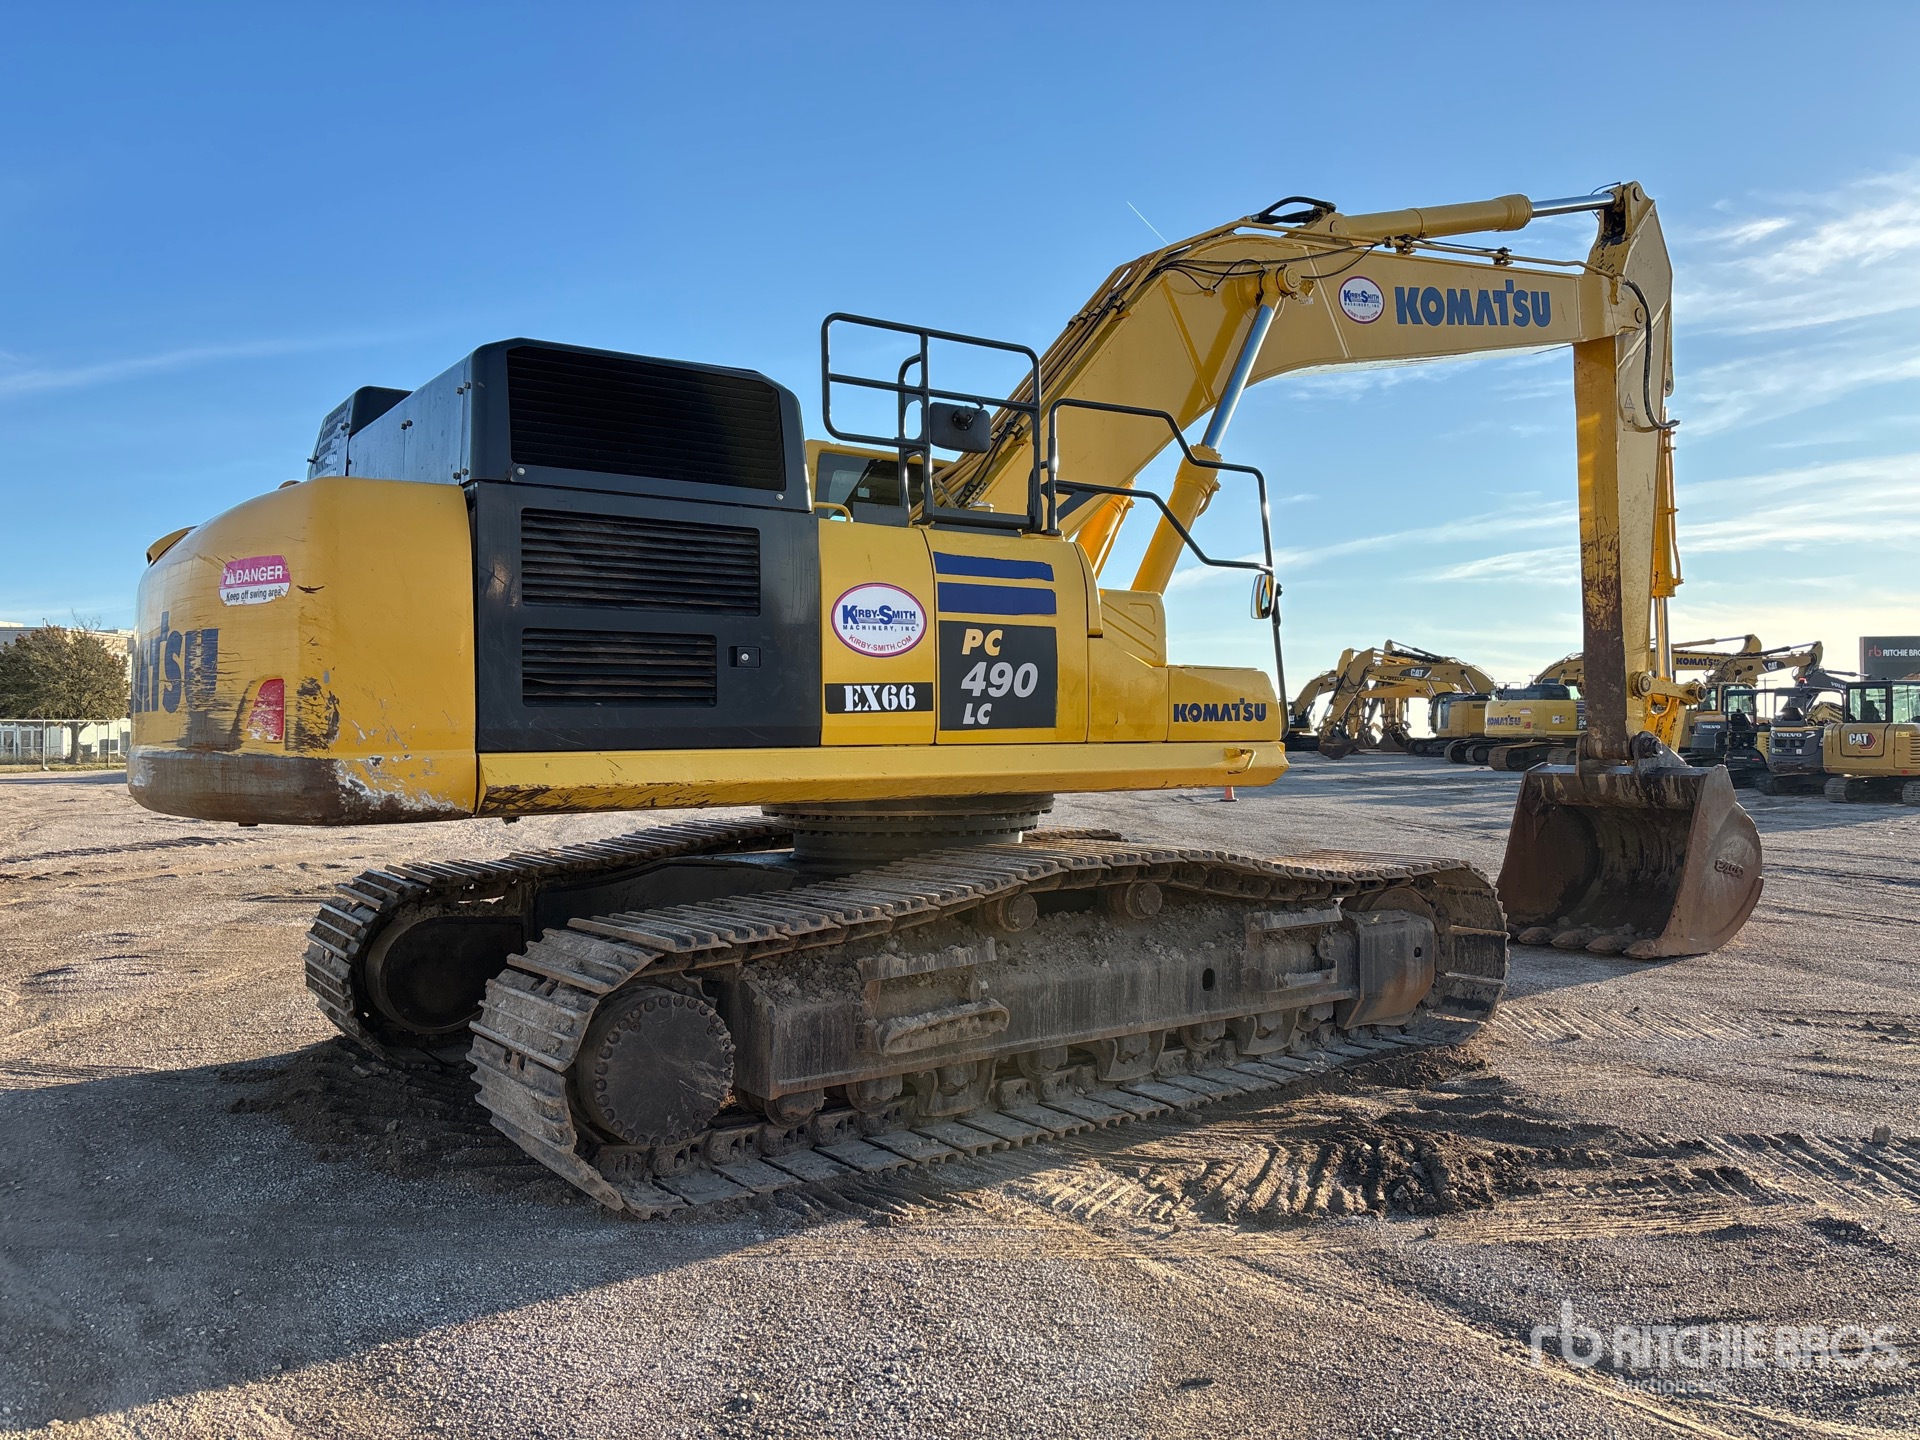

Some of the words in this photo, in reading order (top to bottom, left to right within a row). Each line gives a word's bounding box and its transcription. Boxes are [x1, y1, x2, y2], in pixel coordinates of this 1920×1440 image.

[1394, 279, 1552, 328] KOMATSU
[236, 565, 283, 584] DANGER
[226, 591, 240, 602] Keep
[241, 589, 249, 600] off
[250, 588, 267, 600] swing
[842, 604, 917, 625] KIRBY-SMITH
[843, 624, 897, 632] MACHINERY,
[849, 634, 913, 652] KIRBY-SMITH.COM
[961, 628, 1003, 656] PC
[1882, 649, 1908, 657] RITCHIE
[1410, 668, 1424, 677] CAT
[1767, 662, 1778, 671] CAT
[960, 661, 1039, 698] 490
[843, 684, 916, 712] EX66
[962, 702, 992, 725] LC
[1173, 697, 1267, 722] KOMATSU
[1848, 733, 1869, 746] CAT
